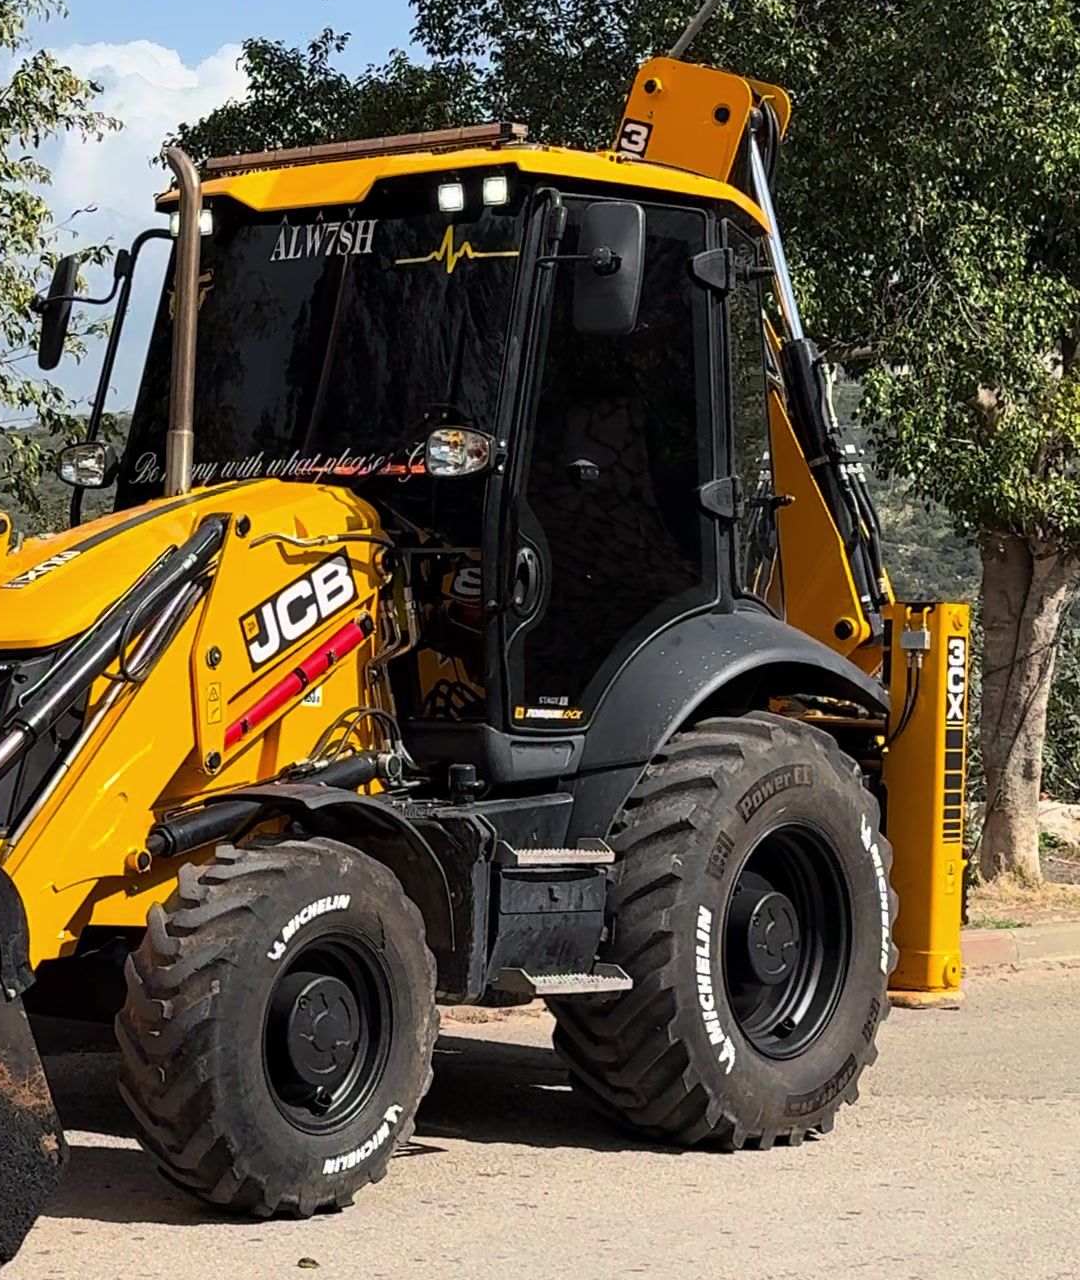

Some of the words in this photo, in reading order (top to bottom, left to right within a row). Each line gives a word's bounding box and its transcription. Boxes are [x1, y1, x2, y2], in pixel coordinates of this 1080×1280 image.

[619, 123, 649, 158] 3
[128, 451, 159, 484] Be
[220, 451, 265, 479] with
[266, 449, 321, 476] what
[249, 556, 354, 663] JCB
[946, 639, 965, 719] 3CX
[740, 773, 791, 818] Power
[282, 894, 350, 942] MICHELIN
[870, 843, 889, 975] MICHELIN
[695, 905, 726, 1045] MICHELIN
[322, 1121, 390, 1174] MICHELIN
